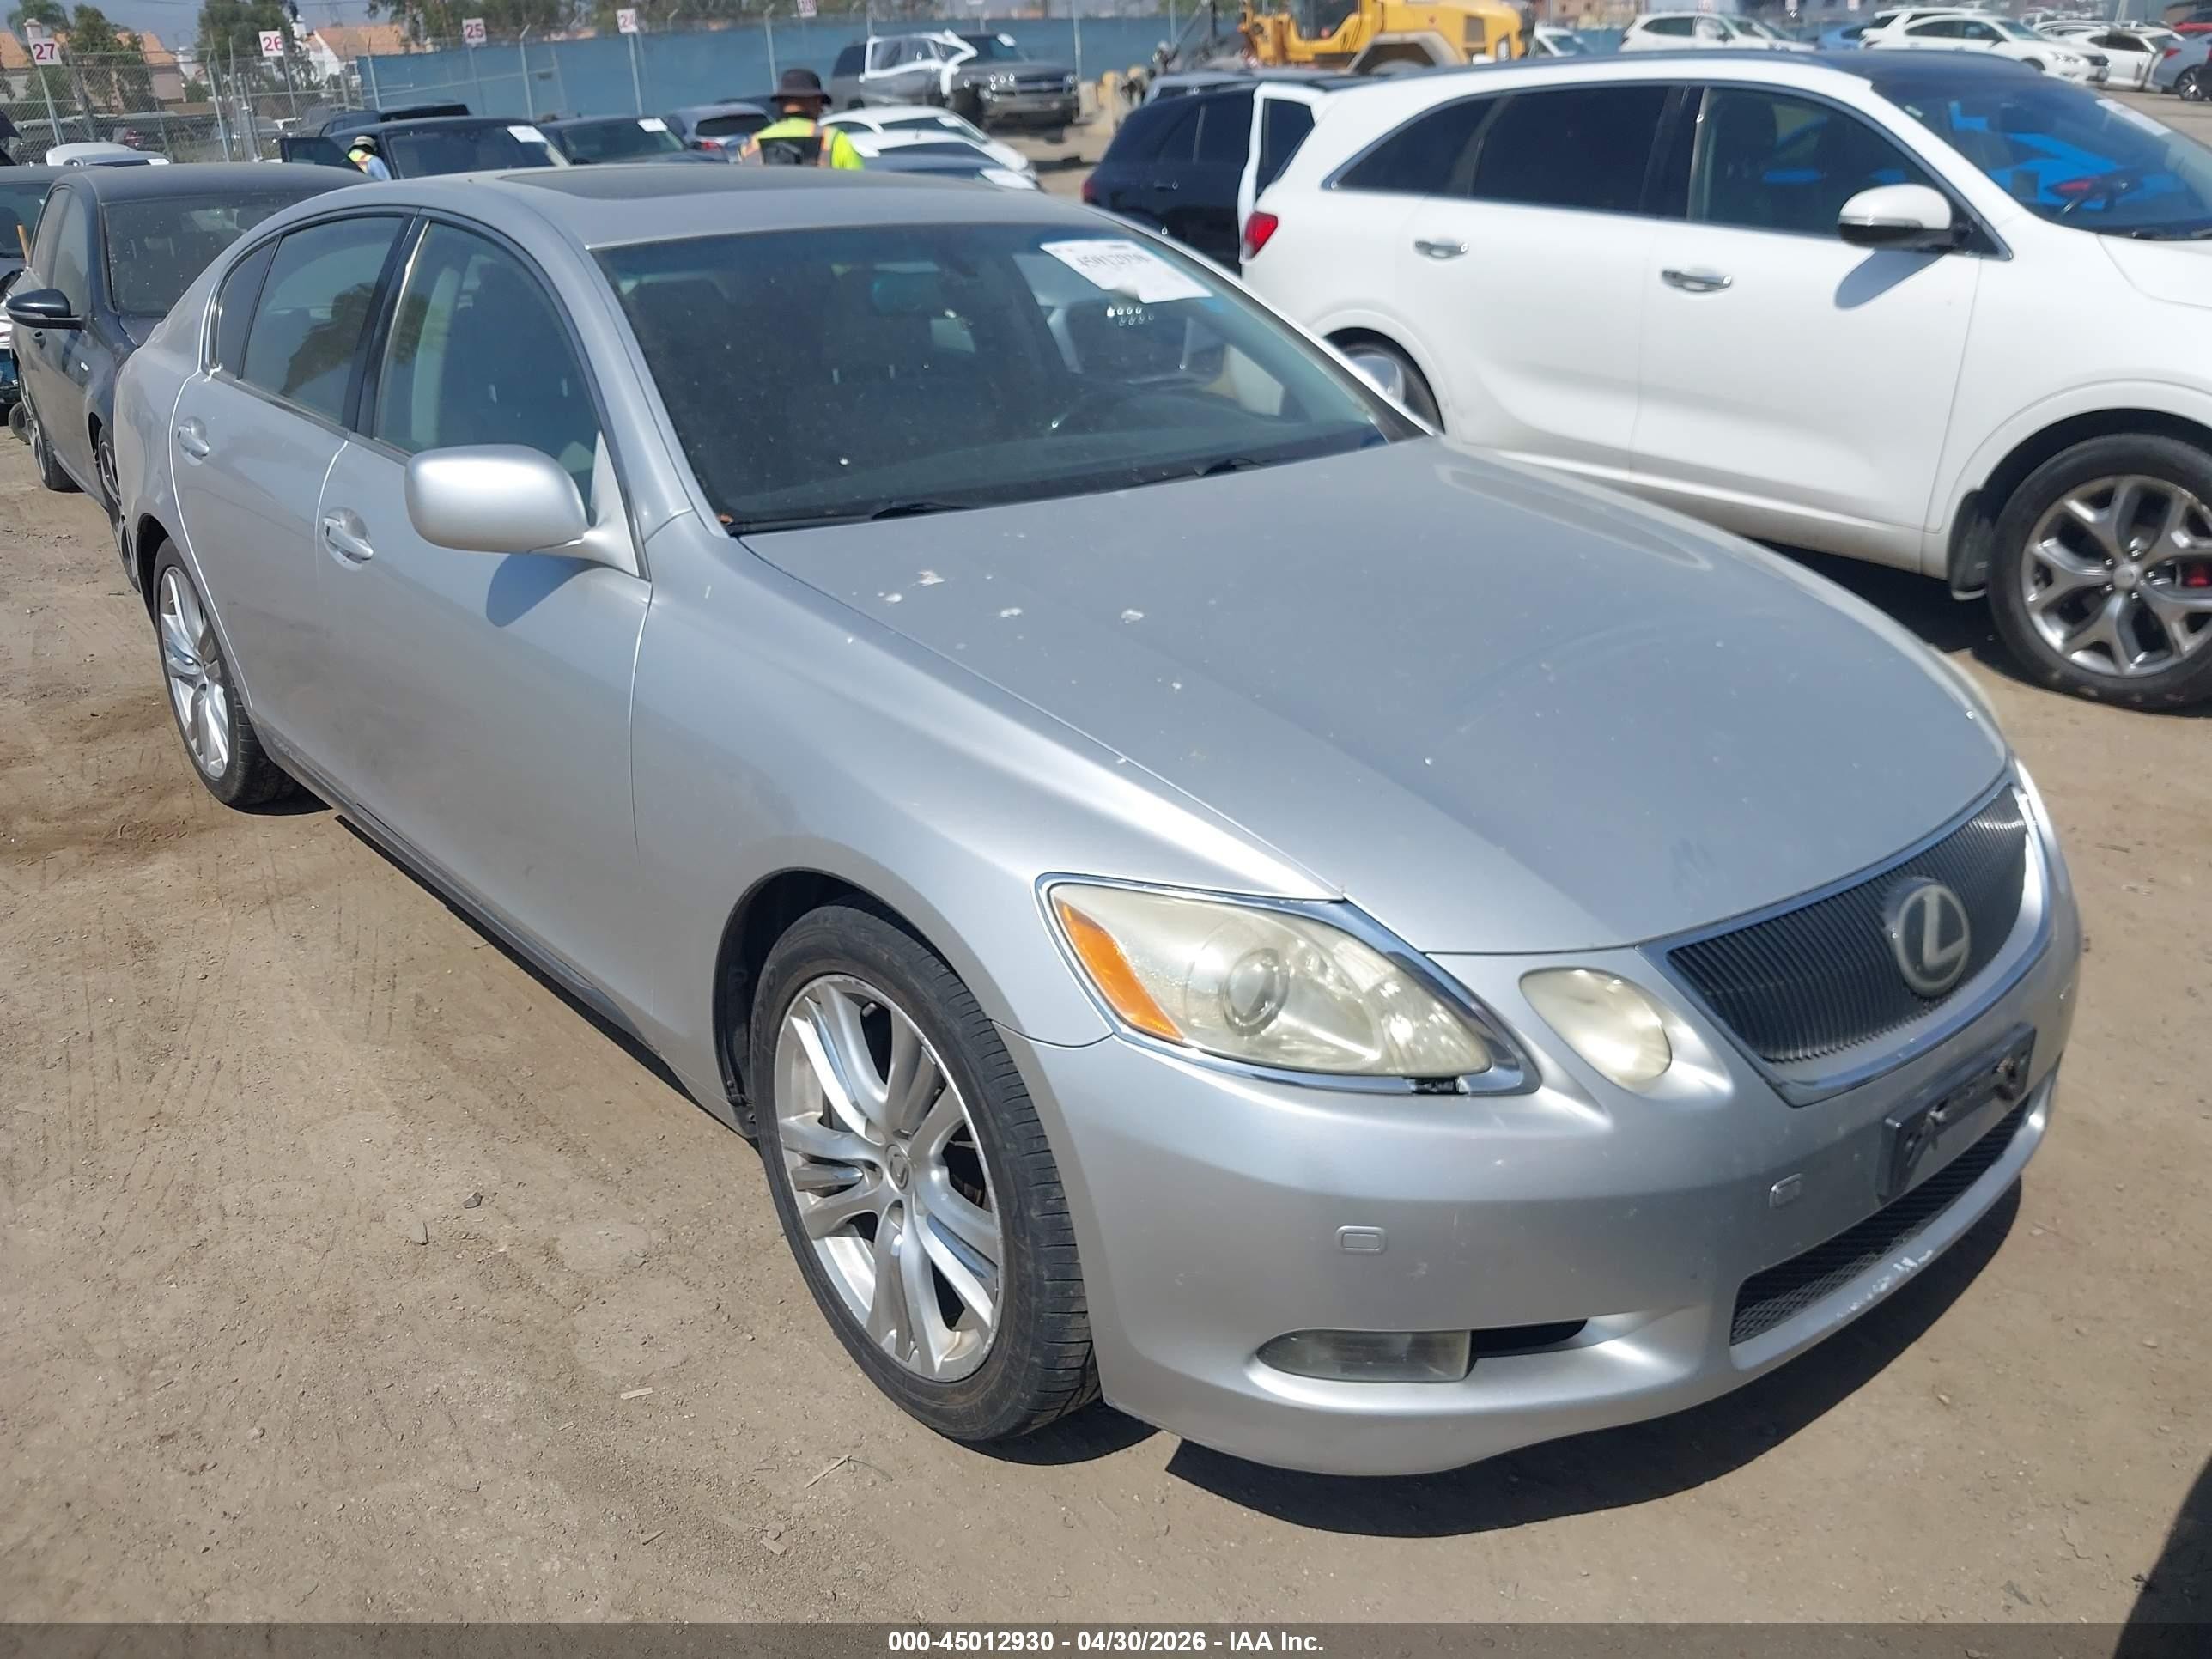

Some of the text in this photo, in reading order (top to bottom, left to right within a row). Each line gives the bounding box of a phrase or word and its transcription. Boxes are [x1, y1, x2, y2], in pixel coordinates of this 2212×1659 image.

[620, 14, 634, 27] 2
[466, 24, 484, 39] 25
[263, 36, 283, 51] 26
[33, 43, 55, 60] 27
